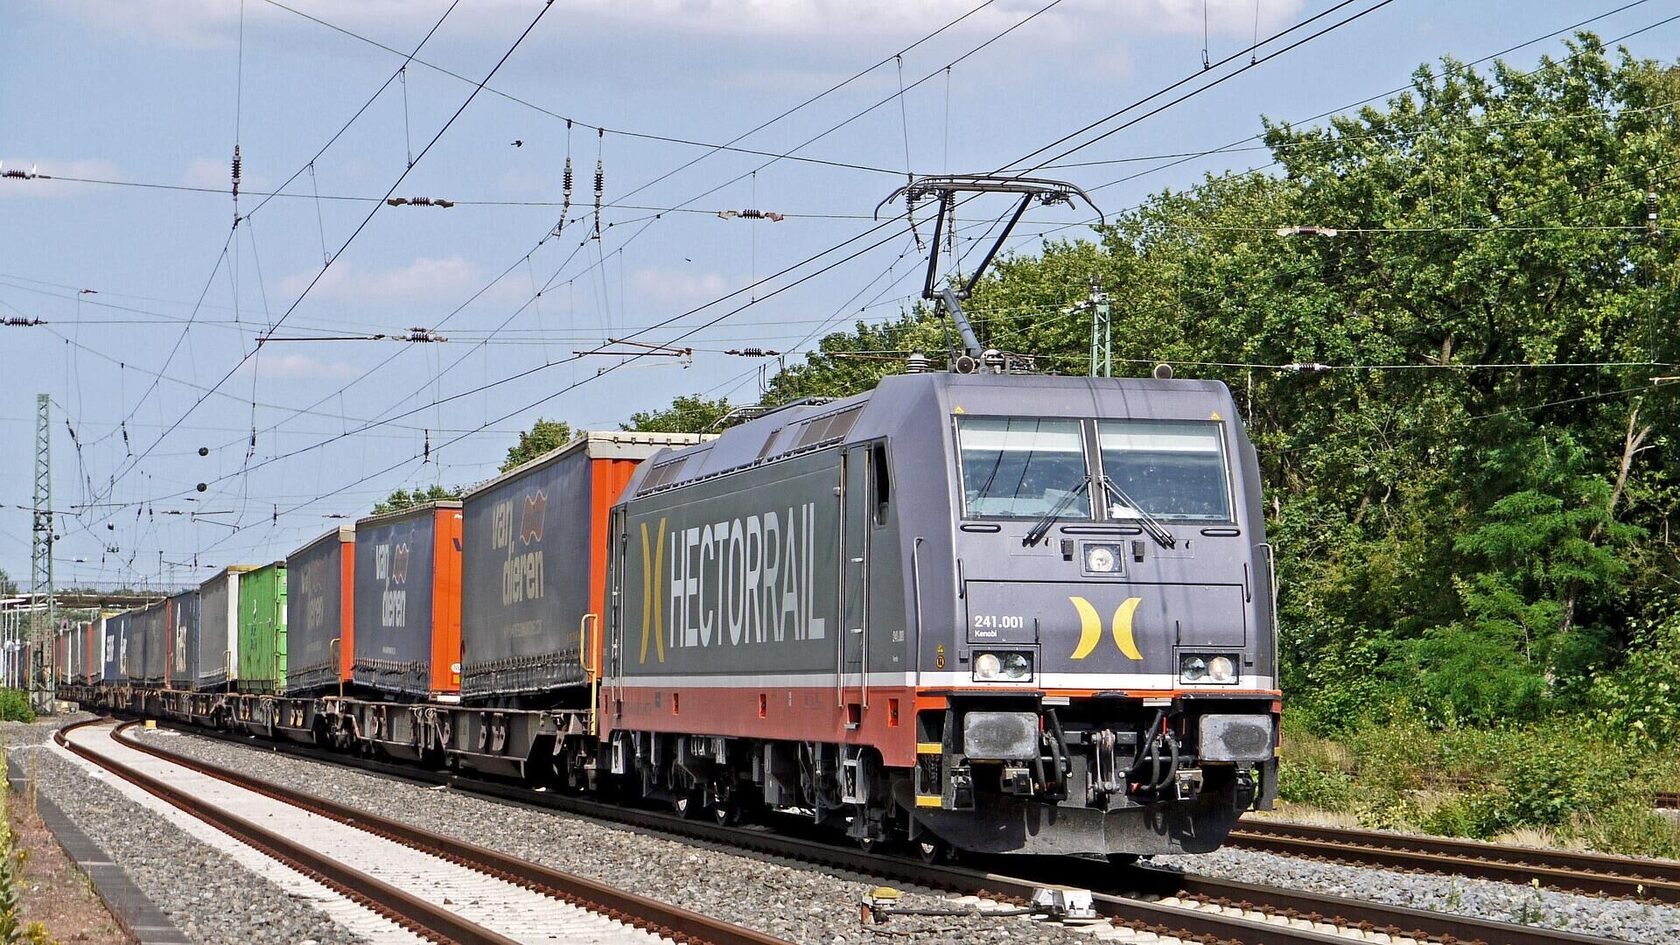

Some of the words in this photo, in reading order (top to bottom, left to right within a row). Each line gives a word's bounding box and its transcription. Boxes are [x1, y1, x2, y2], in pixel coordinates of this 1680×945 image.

[492, 499, 513, 550] van
[375, 544, 389, 580] van
[502, 541, 544, 607] dieren
[670, 502, 825, 648] HECTORRAIL
[974, 615, 1023, 628] 241.001
[974, 630, 998, 638] Kenobi
